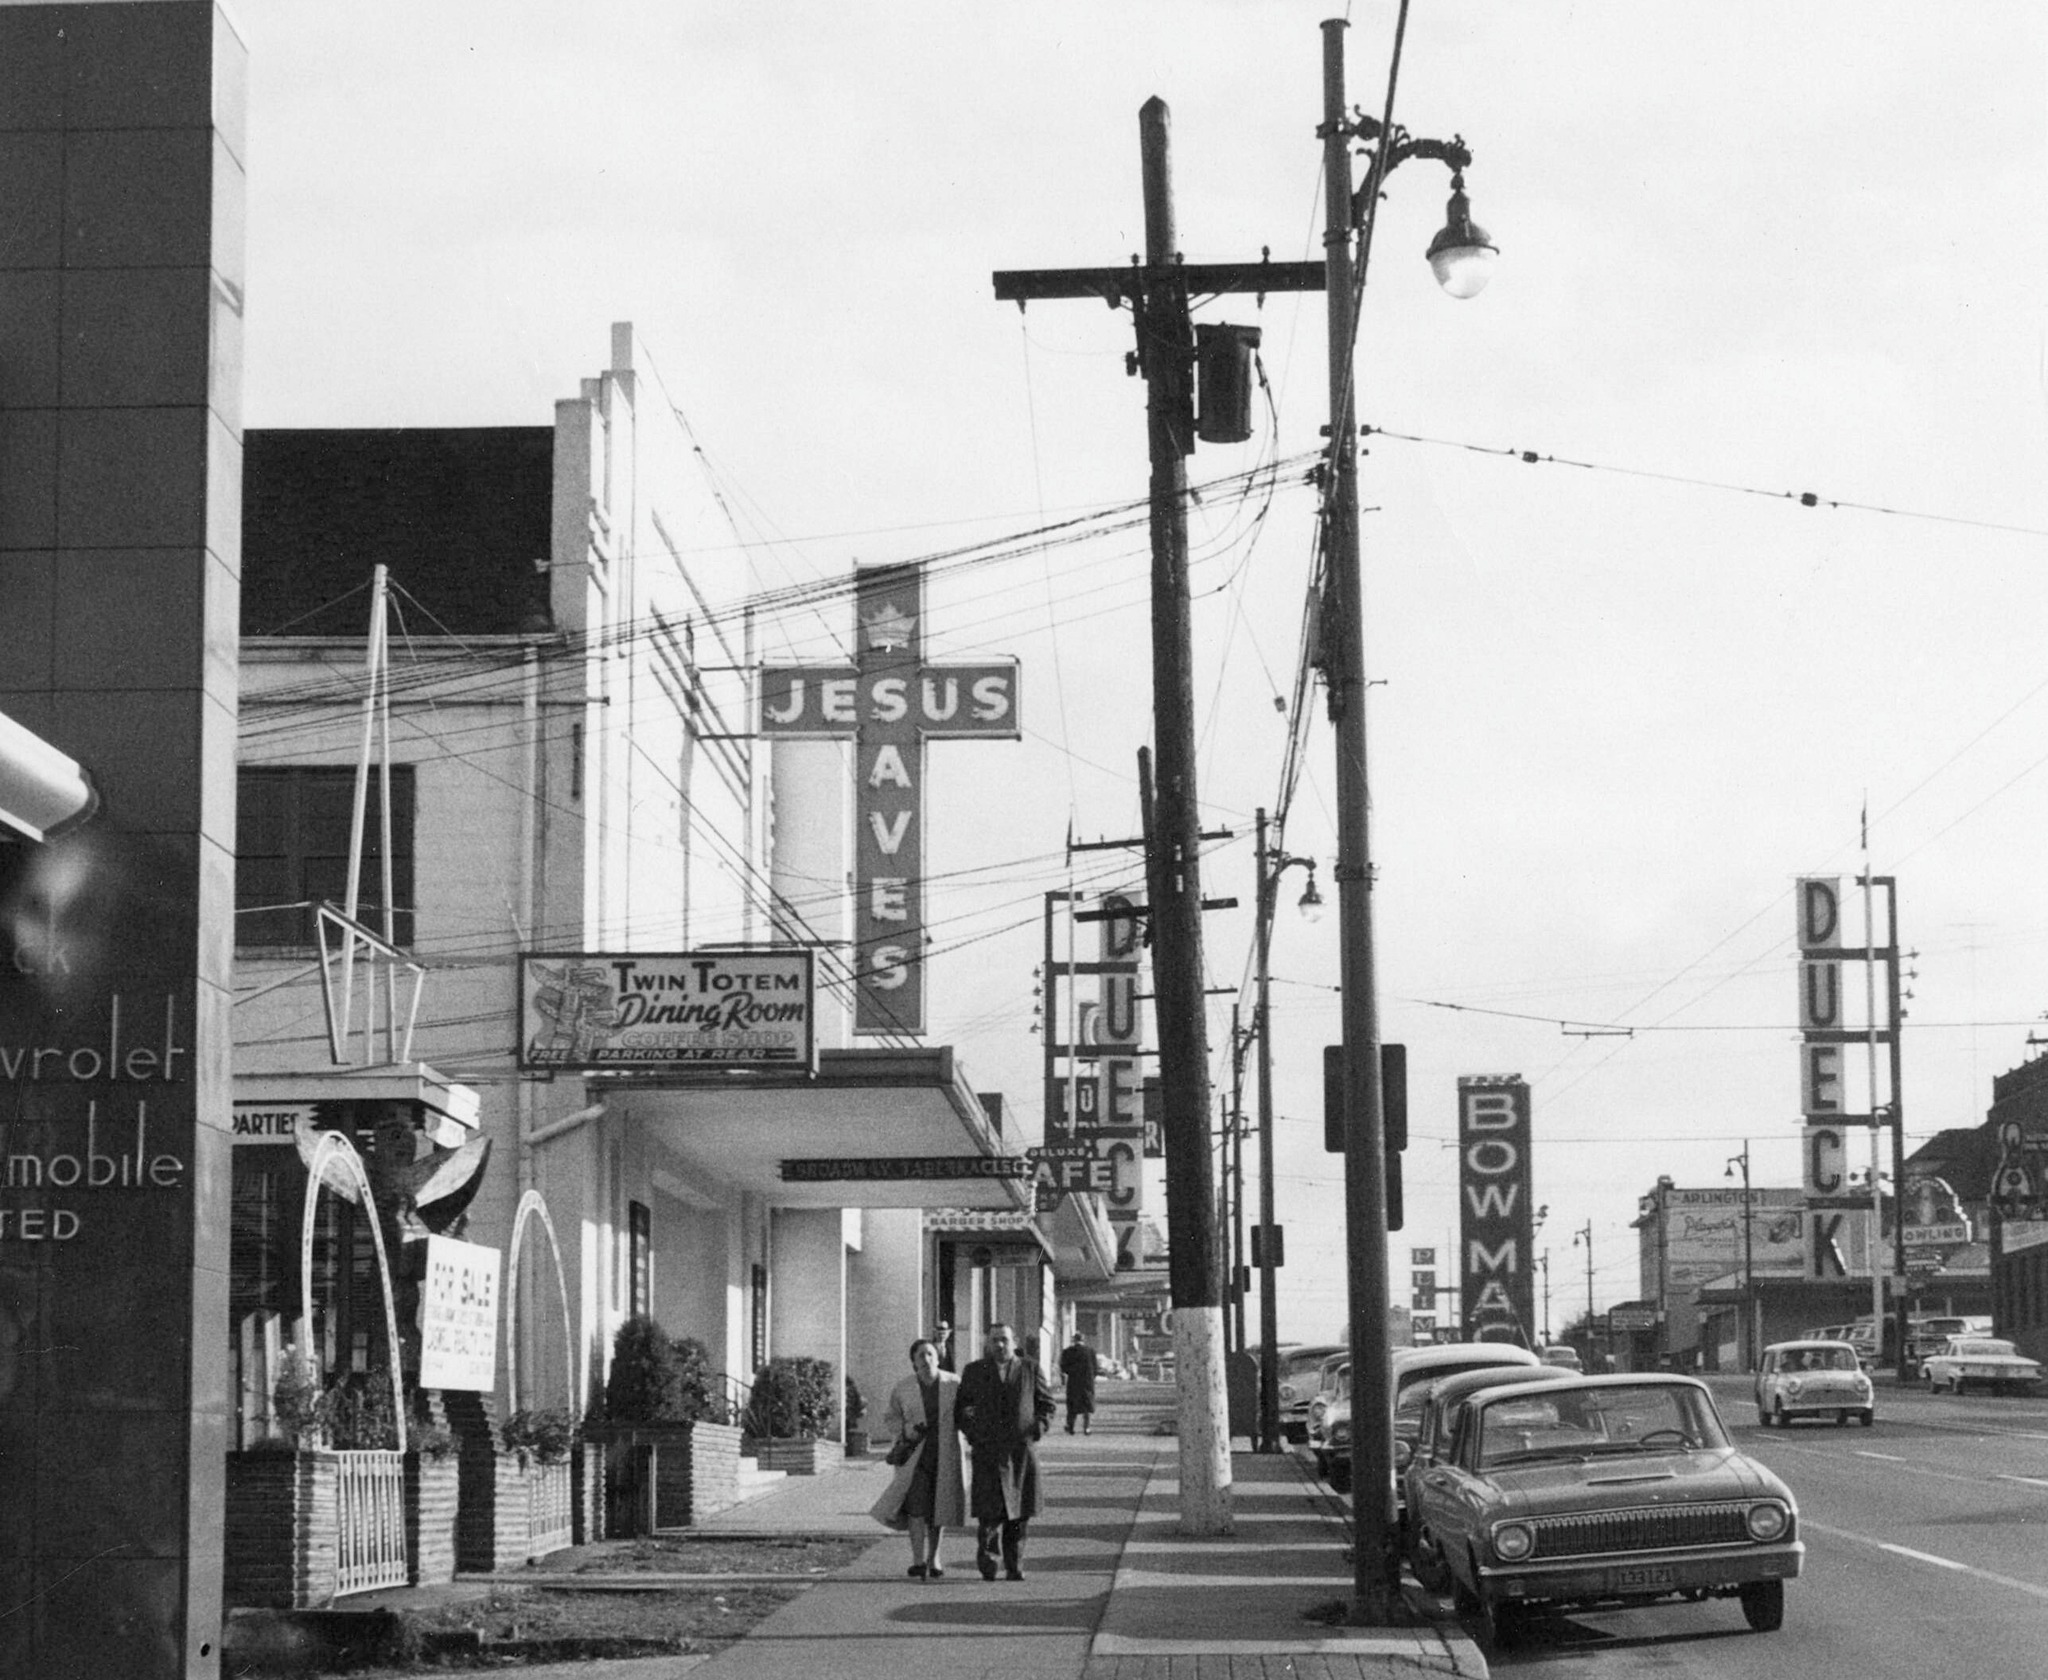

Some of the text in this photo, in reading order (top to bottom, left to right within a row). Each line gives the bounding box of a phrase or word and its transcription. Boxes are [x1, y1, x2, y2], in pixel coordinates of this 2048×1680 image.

[765, 676, 1010, 724] JESUS
[610, 991, 805, 1032] Dining Room
[621, 1030, 794, 1048] COFFEE SHOP
[529, 1049, 766, 1060] FREE PARKING AT REAR
[1805, 880, 1847, 1277] DUECK
[8, 1100, 184, 1186] mobile
[1029, 1147, 1086, 1158] DELUXE
[1012, 1157, 1112, 1189] CAFE
[929, 1215, 1026, 1227] BARBER SHOP
[1903, 1226, 1964, 1242] OWLING
